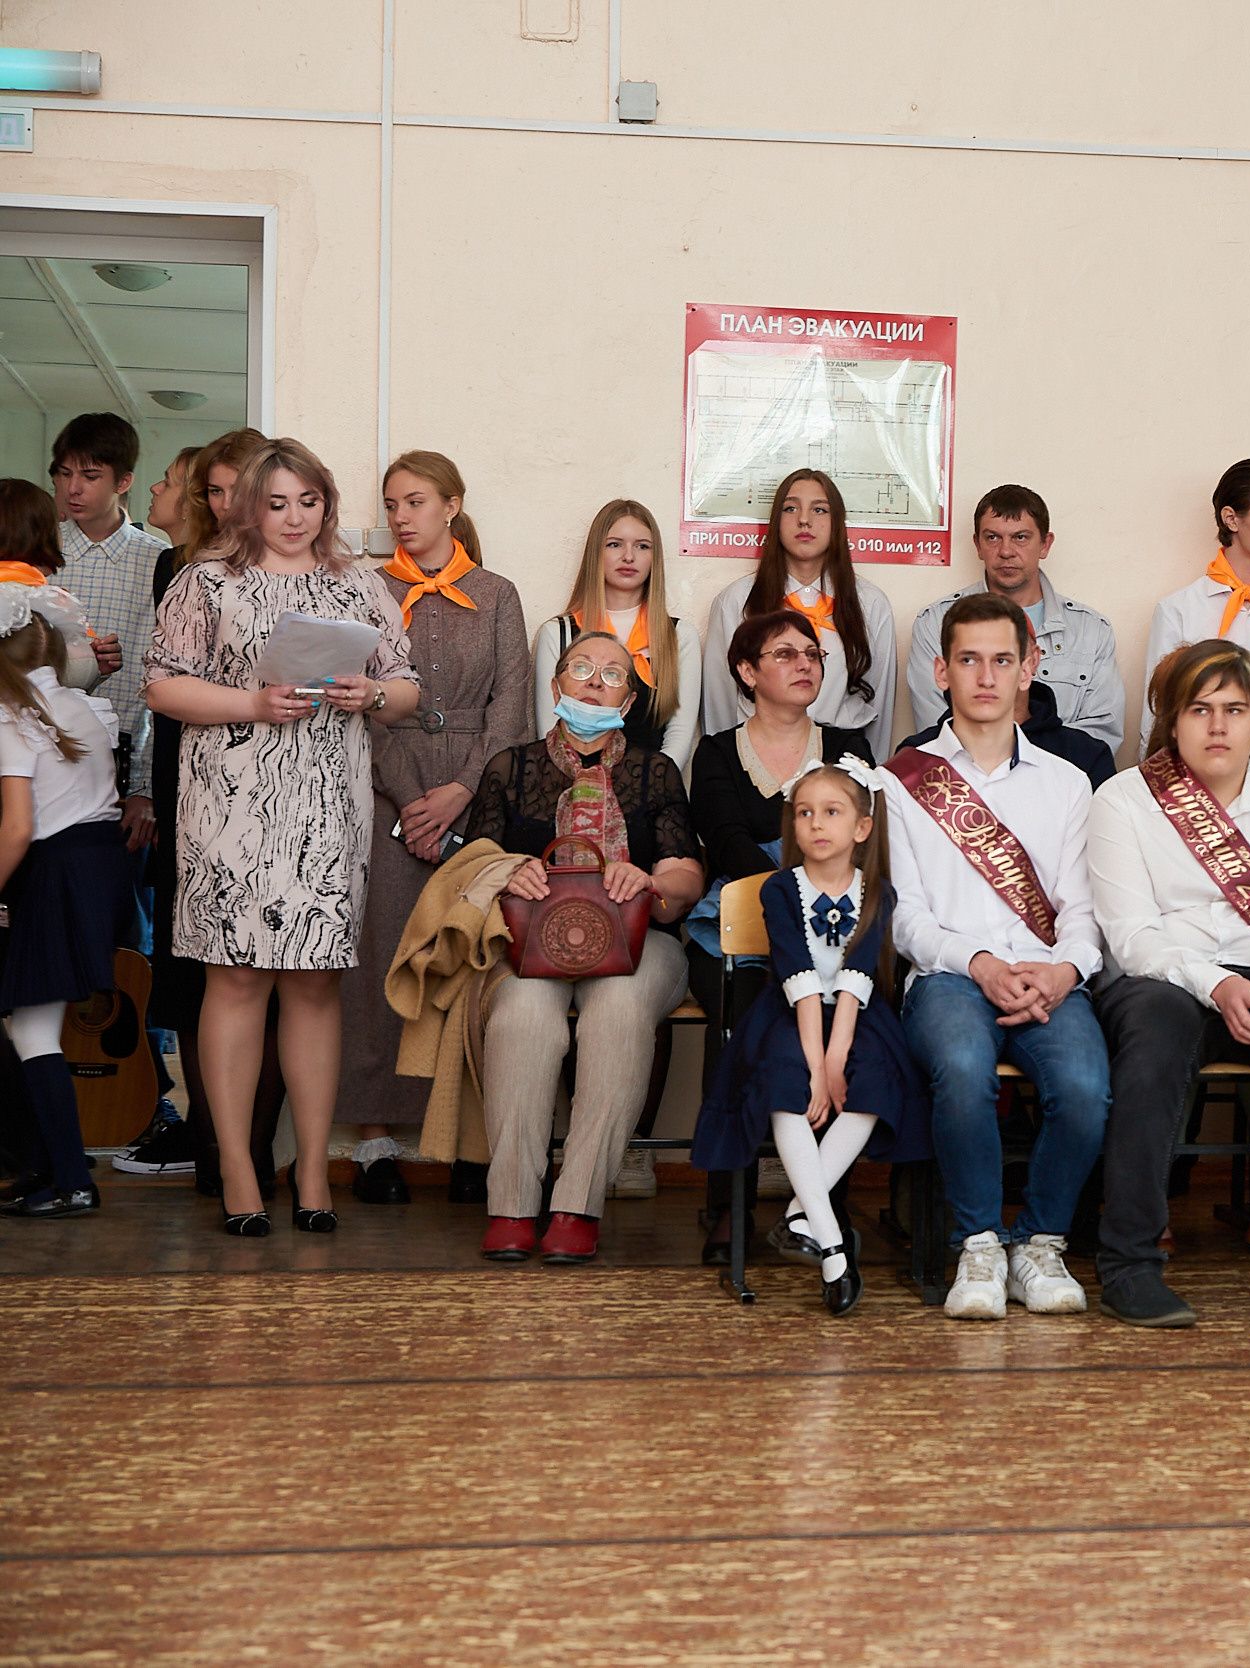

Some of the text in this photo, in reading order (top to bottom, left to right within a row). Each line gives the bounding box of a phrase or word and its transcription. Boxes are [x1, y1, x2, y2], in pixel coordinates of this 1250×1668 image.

[720, 313, 924, 343] ПЛАН ЭВАКУАЦИИ
[810, 360, 858, 368] ЭВКУАЦИИ
[689, 531, 720, 545] ПРИ
[722, 533, 768, 547] ПОЖА
[858, 538, 883, 552] 010
[886, 542, 913, 554] или
[917, 541, 941, 554] 112
[1148, 752, 1248, 879] Выпускник
